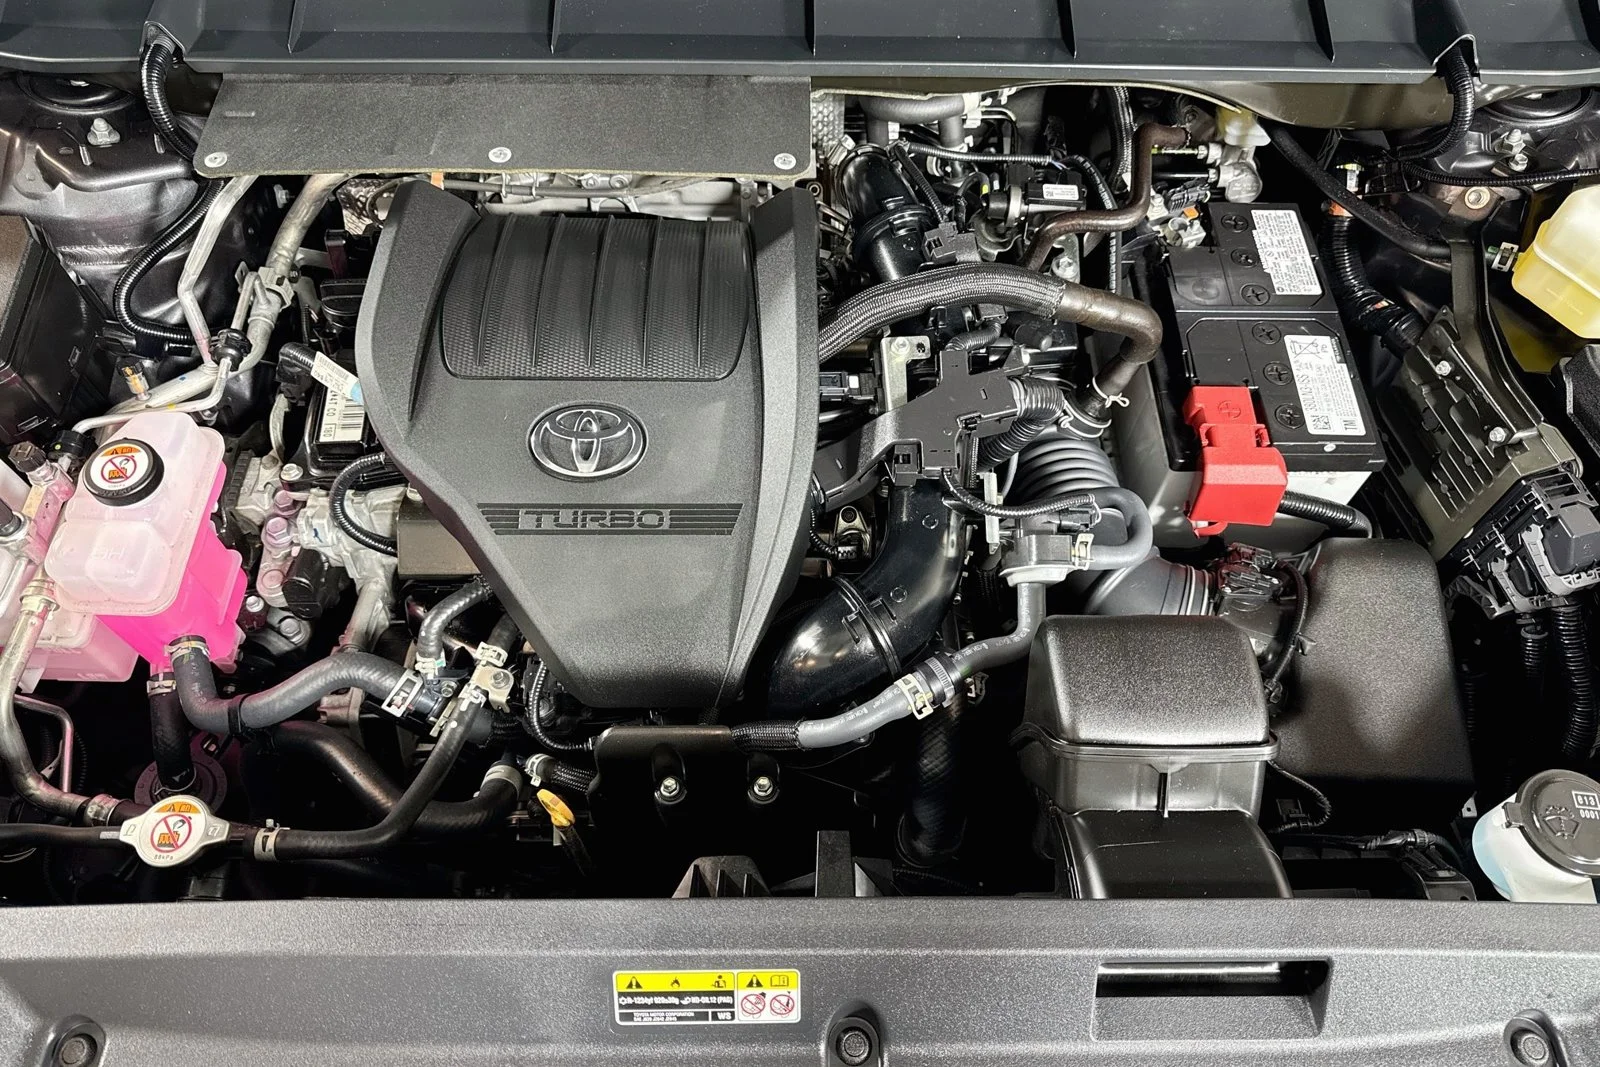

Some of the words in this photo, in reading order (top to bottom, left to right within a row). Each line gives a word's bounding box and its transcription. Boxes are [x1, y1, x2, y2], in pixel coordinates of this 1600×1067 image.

[1342, 419, 1358, 431] TM
[524, 509, 665, 529] TURBO
[1579, 809, 1599, 820] 0001
[717, 1011, 732, 1020] WS
